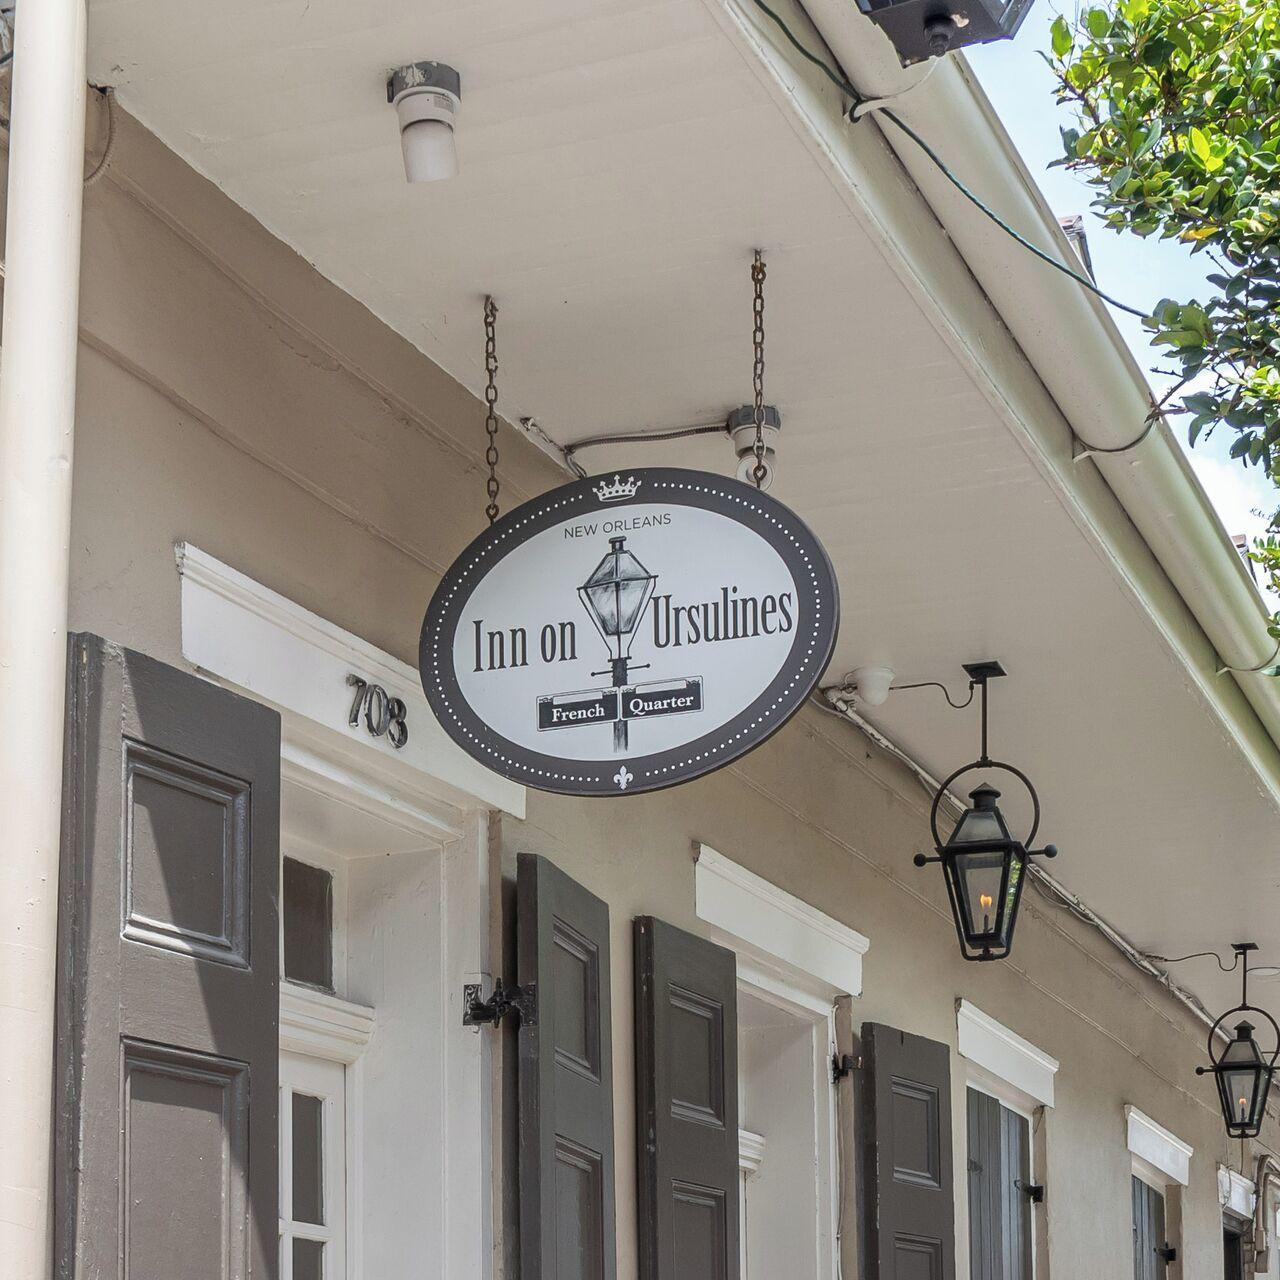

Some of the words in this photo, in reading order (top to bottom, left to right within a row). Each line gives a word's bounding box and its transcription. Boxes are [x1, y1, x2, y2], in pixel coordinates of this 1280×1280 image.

[564, 523, 598, 539] NEW
[602, 513, 672, 534] ORLEANS
[472, 619, 529, 673] Inn
[540, 619, 578, 663] on
[650, 584, 794, 649] Ursulines
[345, 673, 409, 750] 708
[551, 703, 606, 723] French
[629, 695, 695, 716] Quarter
